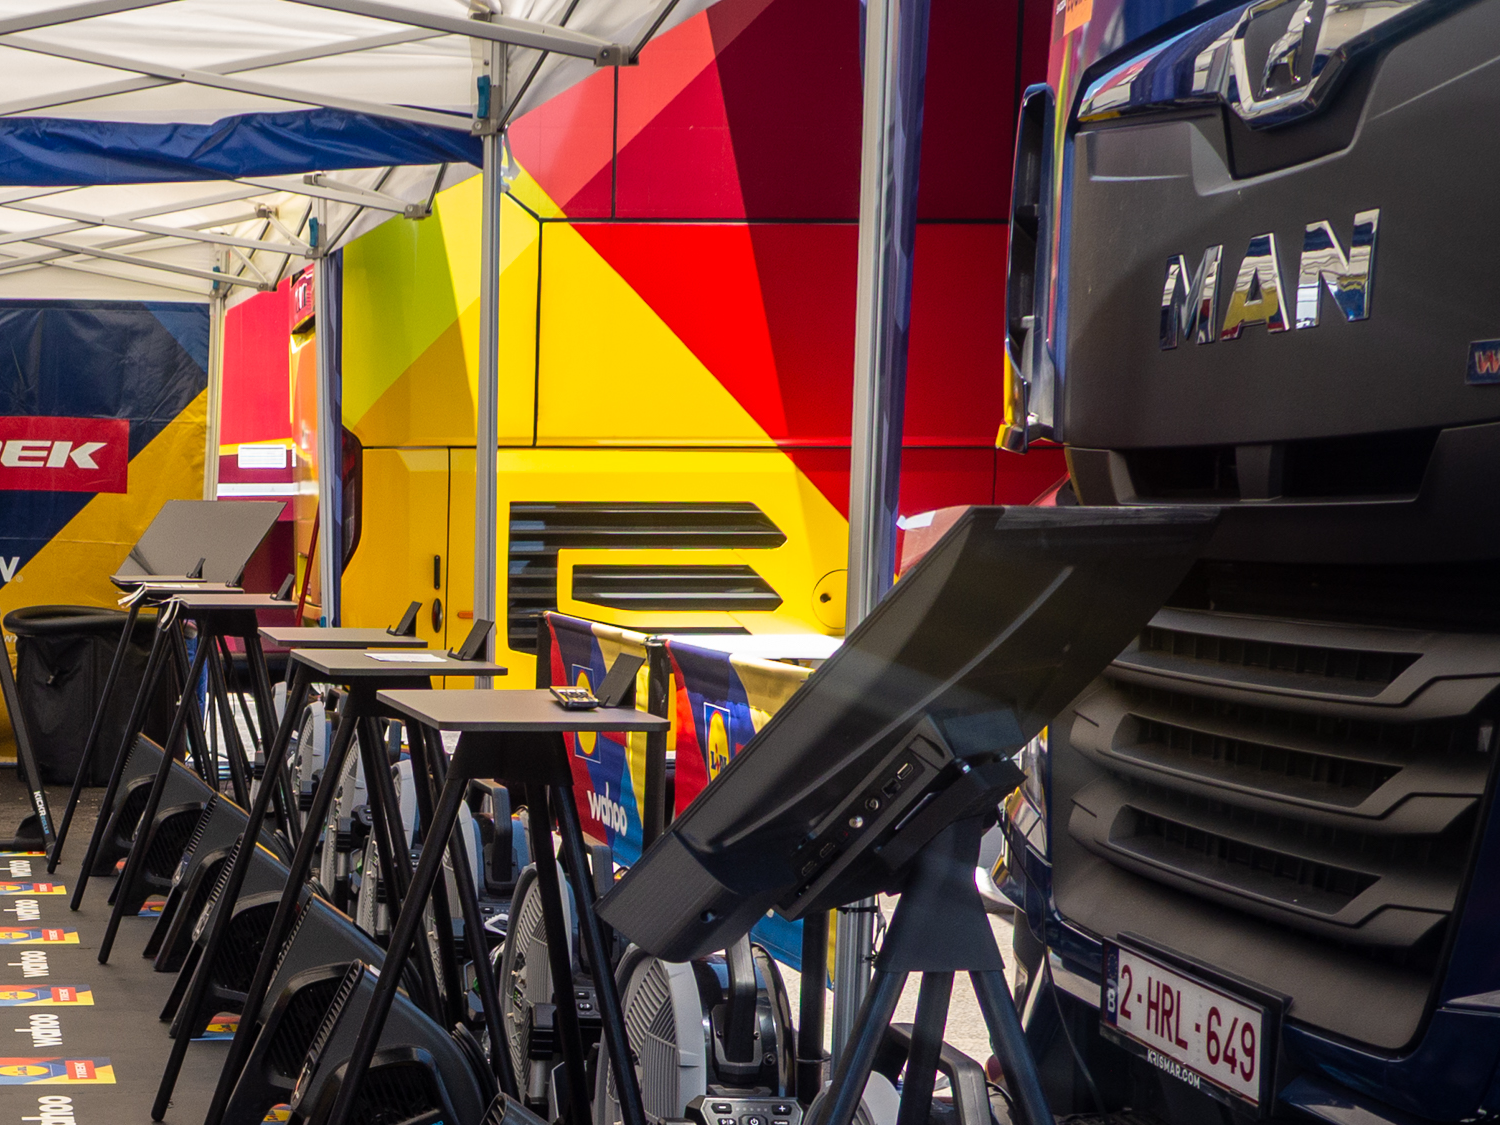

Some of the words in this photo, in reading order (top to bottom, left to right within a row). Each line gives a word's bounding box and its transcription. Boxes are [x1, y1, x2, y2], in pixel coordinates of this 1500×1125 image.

[1160, 208, 1380, 350] MAN
[587, 782, 628, 837] wahoo
[7, 950, 50, 978] wahoo
[14, 1013, 63, 1048] wahoo
[1119, 964, 1256, 1083] 2-HRL-649
[74, 1062, 88, 1079] TREK
[1147, 1049, 1201, 1090] KRISMAR.COM
